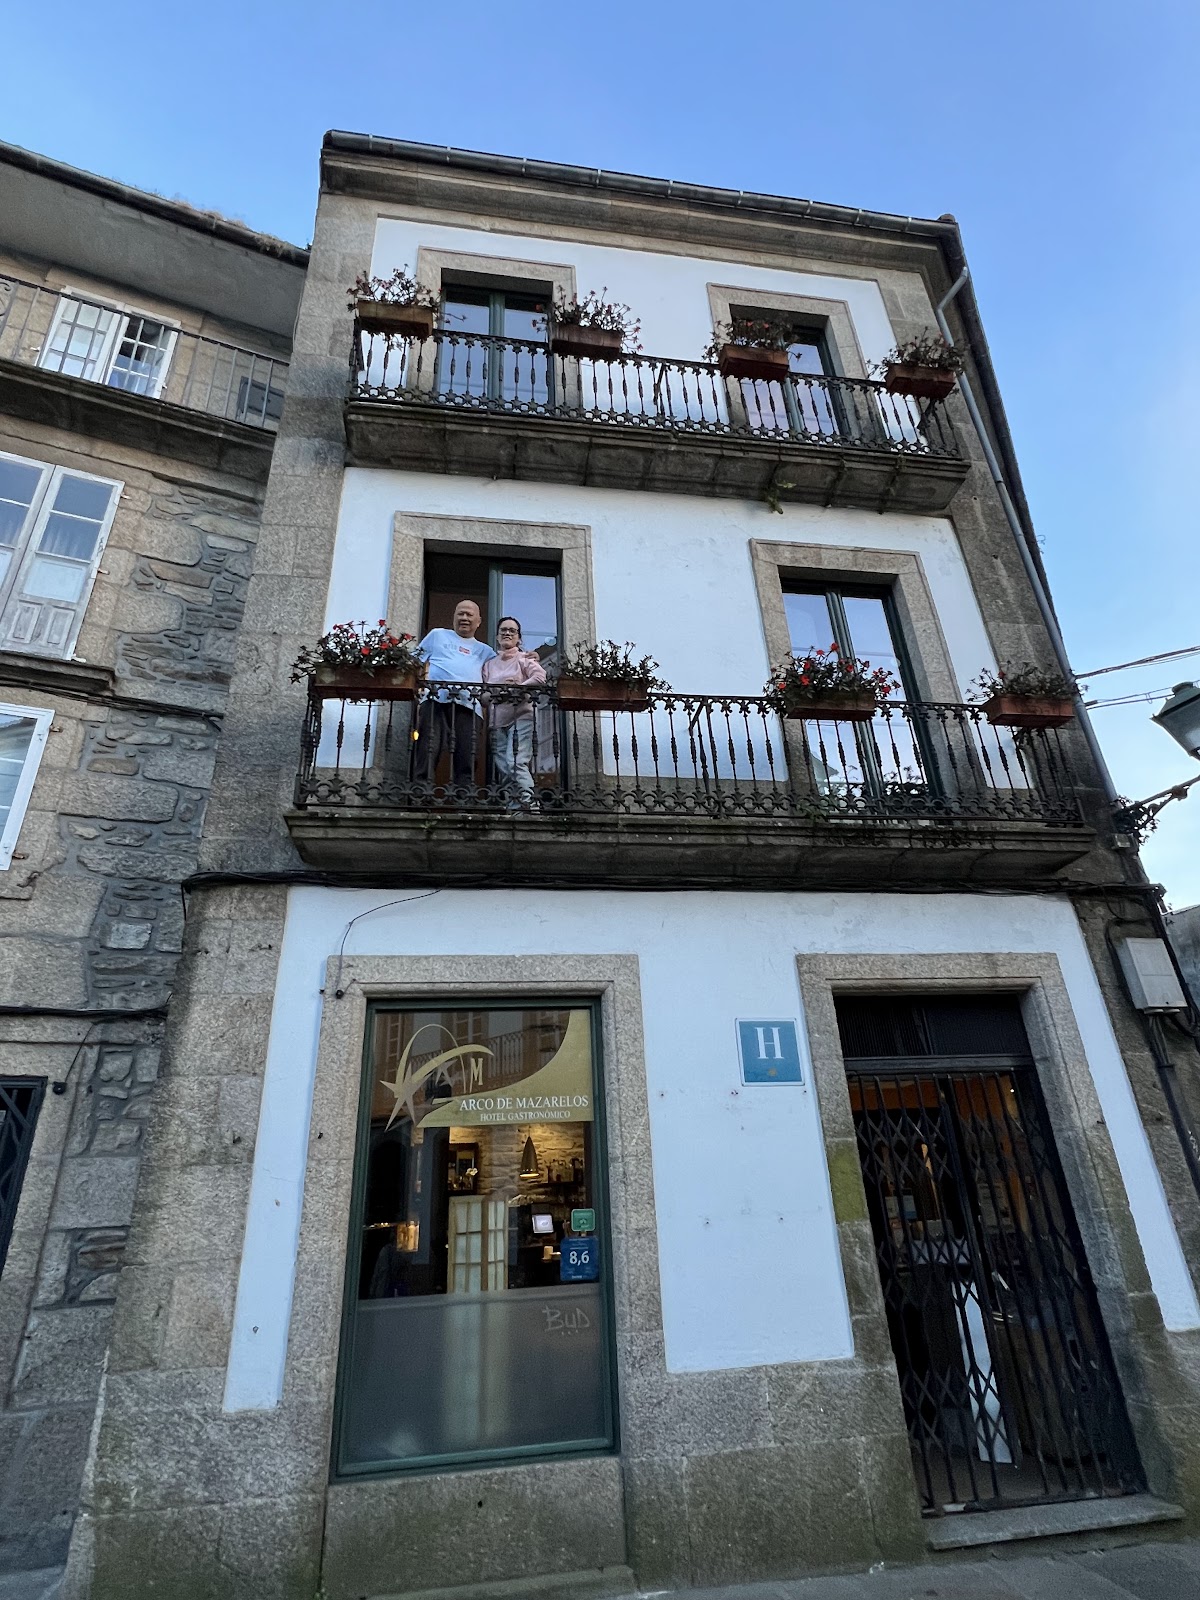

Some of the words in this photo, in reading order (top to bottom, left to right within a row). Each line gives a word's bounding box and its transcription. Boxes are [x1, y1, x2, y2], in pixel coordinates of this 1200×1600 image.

[754, 1027, 784, 1059] H
[460, 1098, 494, 1111] ARCO
[497, 1097, 513, 1110] DE
[516, 1095, 589, 1109] MAZARELOS
[480, 1112, 505, 1122] HOTEL
[507, 1110, 571, 1121] GASTRONÓMICO
[569, 1250, 590, 1266] 8,6
